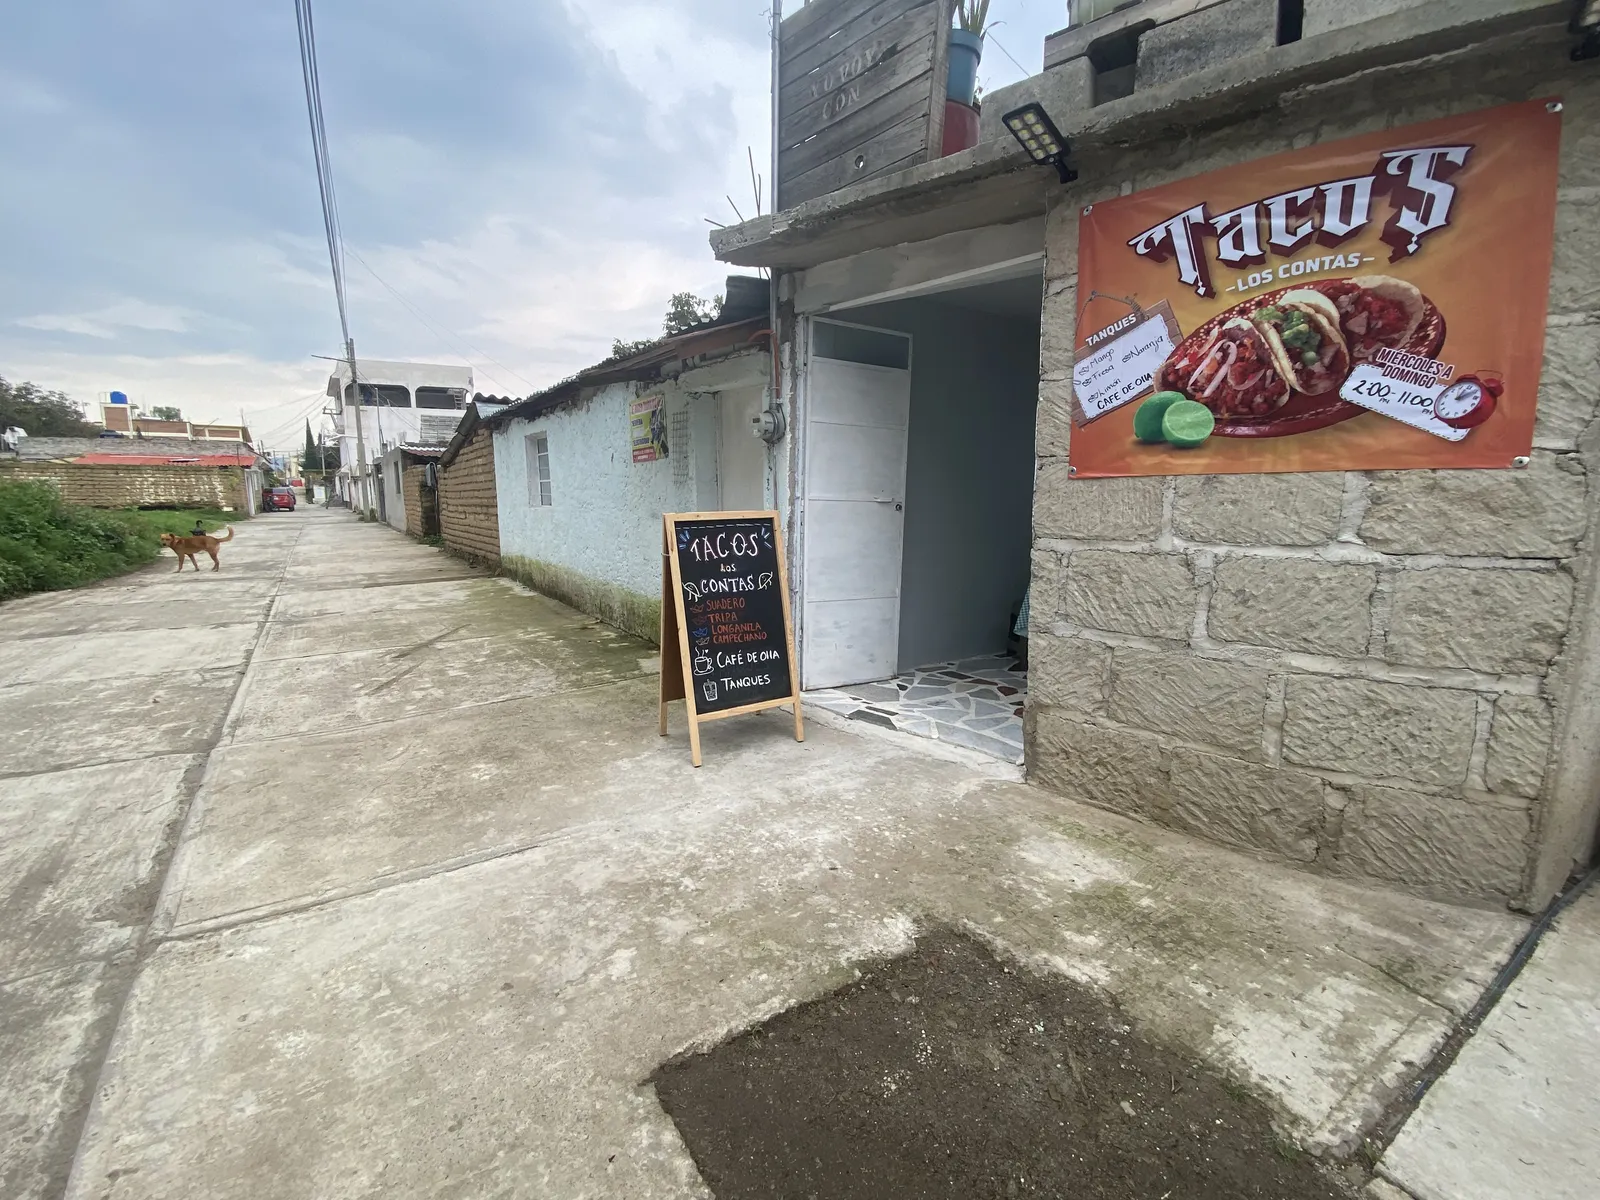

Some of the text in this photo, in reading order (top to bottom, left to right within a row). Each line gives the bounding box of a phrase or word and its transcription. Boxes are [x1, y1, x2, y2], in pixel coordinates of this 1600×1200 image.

[1236, 253, 1361, 292] LOS CONTAS
[1085, 313, 1137, 347] TANQUES
[1130, 335, 1164, 358] Naranja
[1090, 348, 1115, 368] Mango
[1378, 348, 1454, 379] MIÉRCOLES A
[1092, 365, 1115, 381] Fresa
[1382, 364, 1437, 389] DOMINGO
[1097, 391, 1121, 410] CAFE
[1121, 383, 1135, 395] DE
[690, 532, 759, 562] TACOS
[701, 574, 755, 594] CONTAS
[706, 597, 746, 612] SUADERO
[708, 611, 738, 624] TRIPA
[713, 631, 768, 645] CAMPECHANO
[716, 649, 744, 669] CAFÉ
[746, 651, 758, 663] DE
[720, 673, 771, 692] TANQUES
